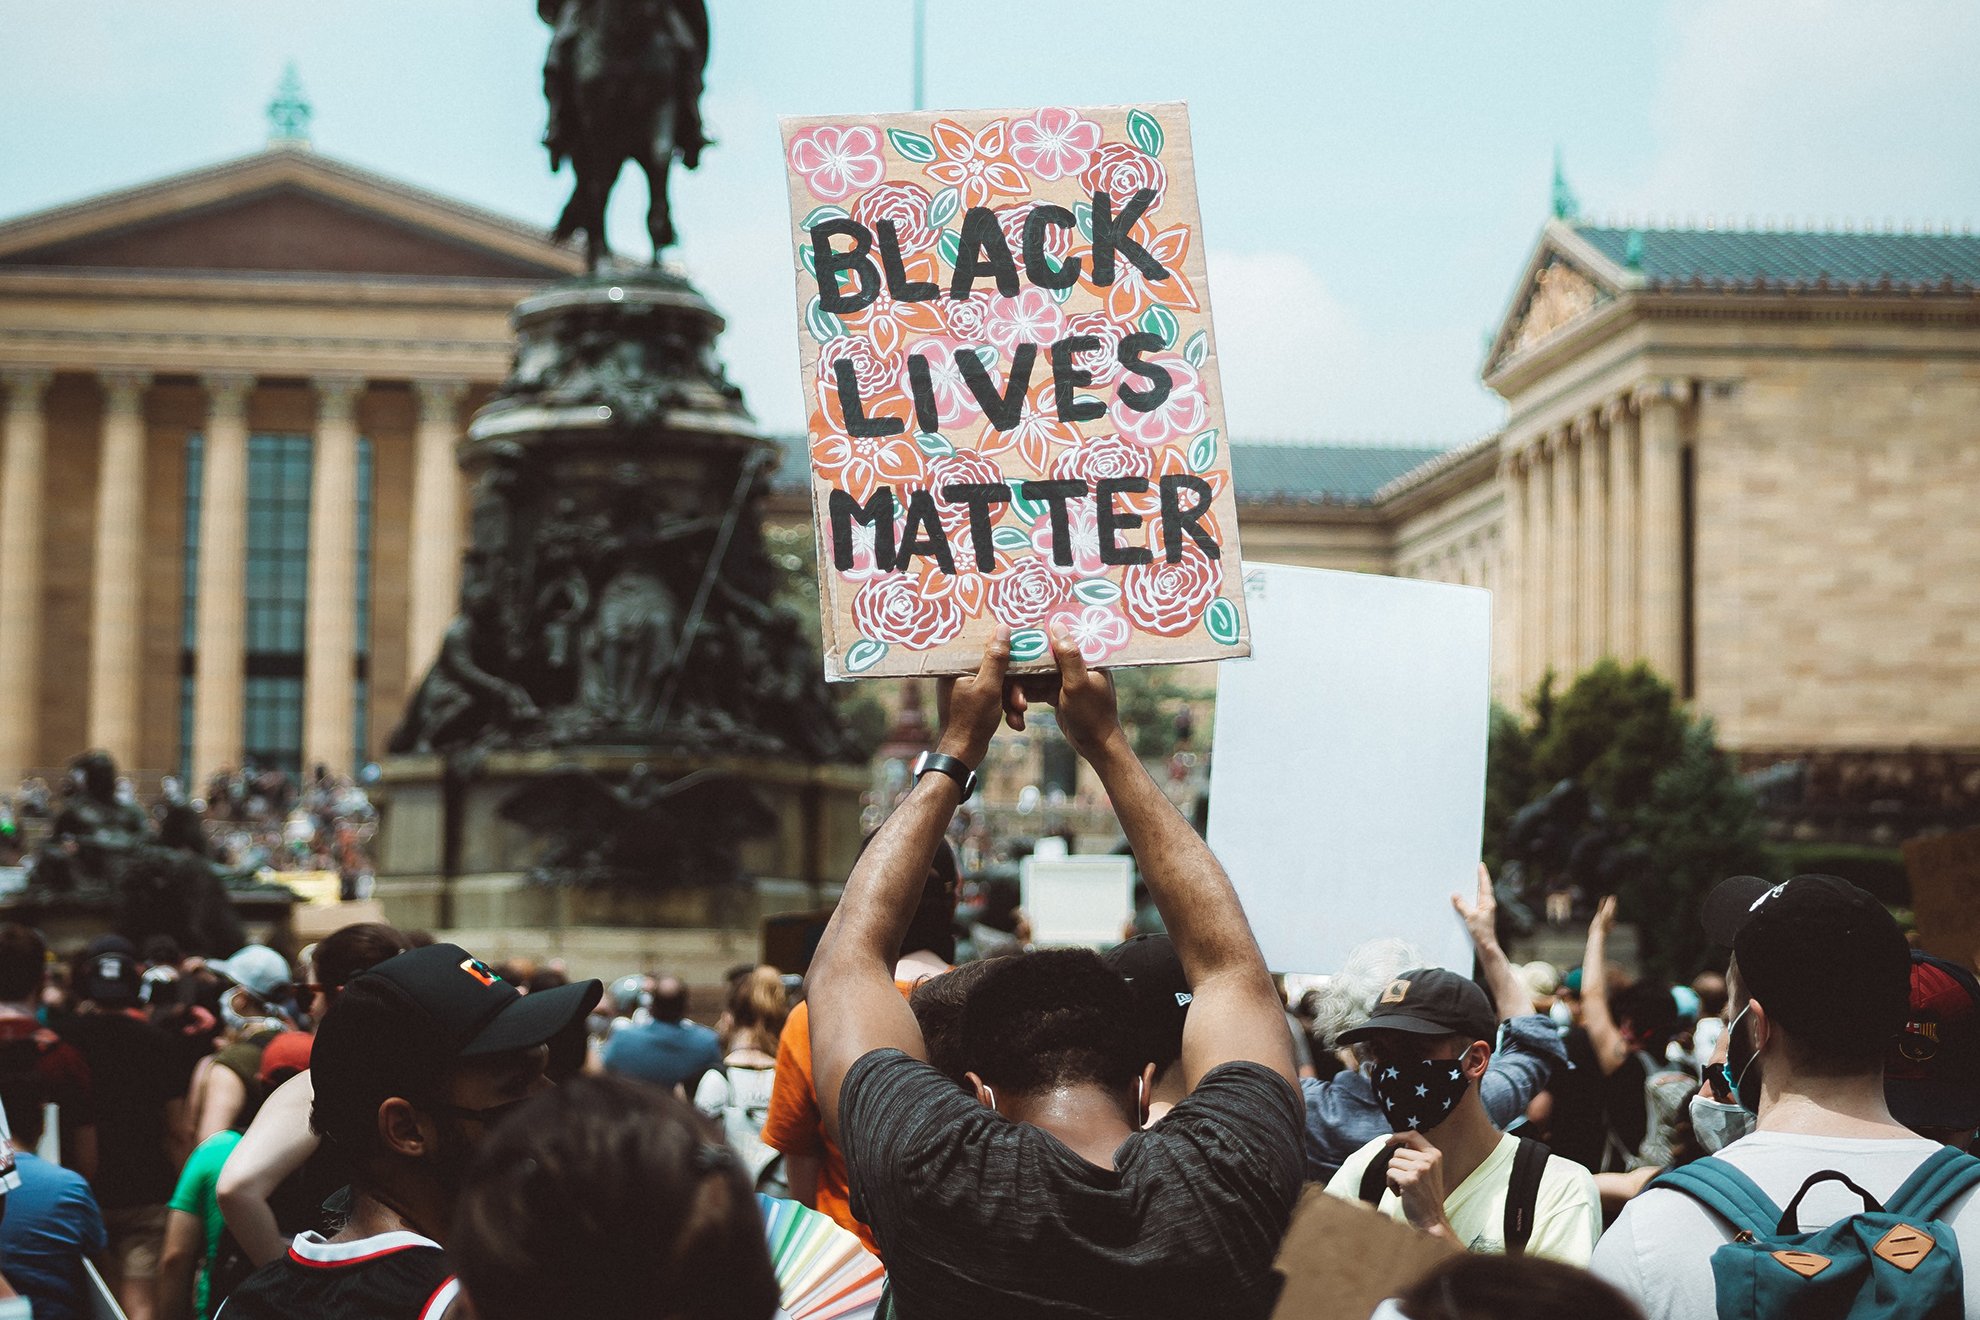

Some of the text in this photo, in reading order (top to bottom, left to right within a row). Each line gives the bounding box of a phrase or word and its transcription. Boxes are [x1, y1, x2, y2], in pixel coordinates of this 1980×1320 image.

[810, 188, 1170, 314] BLACK
[833, 332, 1173, 437] LIVES
[828, 474, 1221, 575] MATTER
